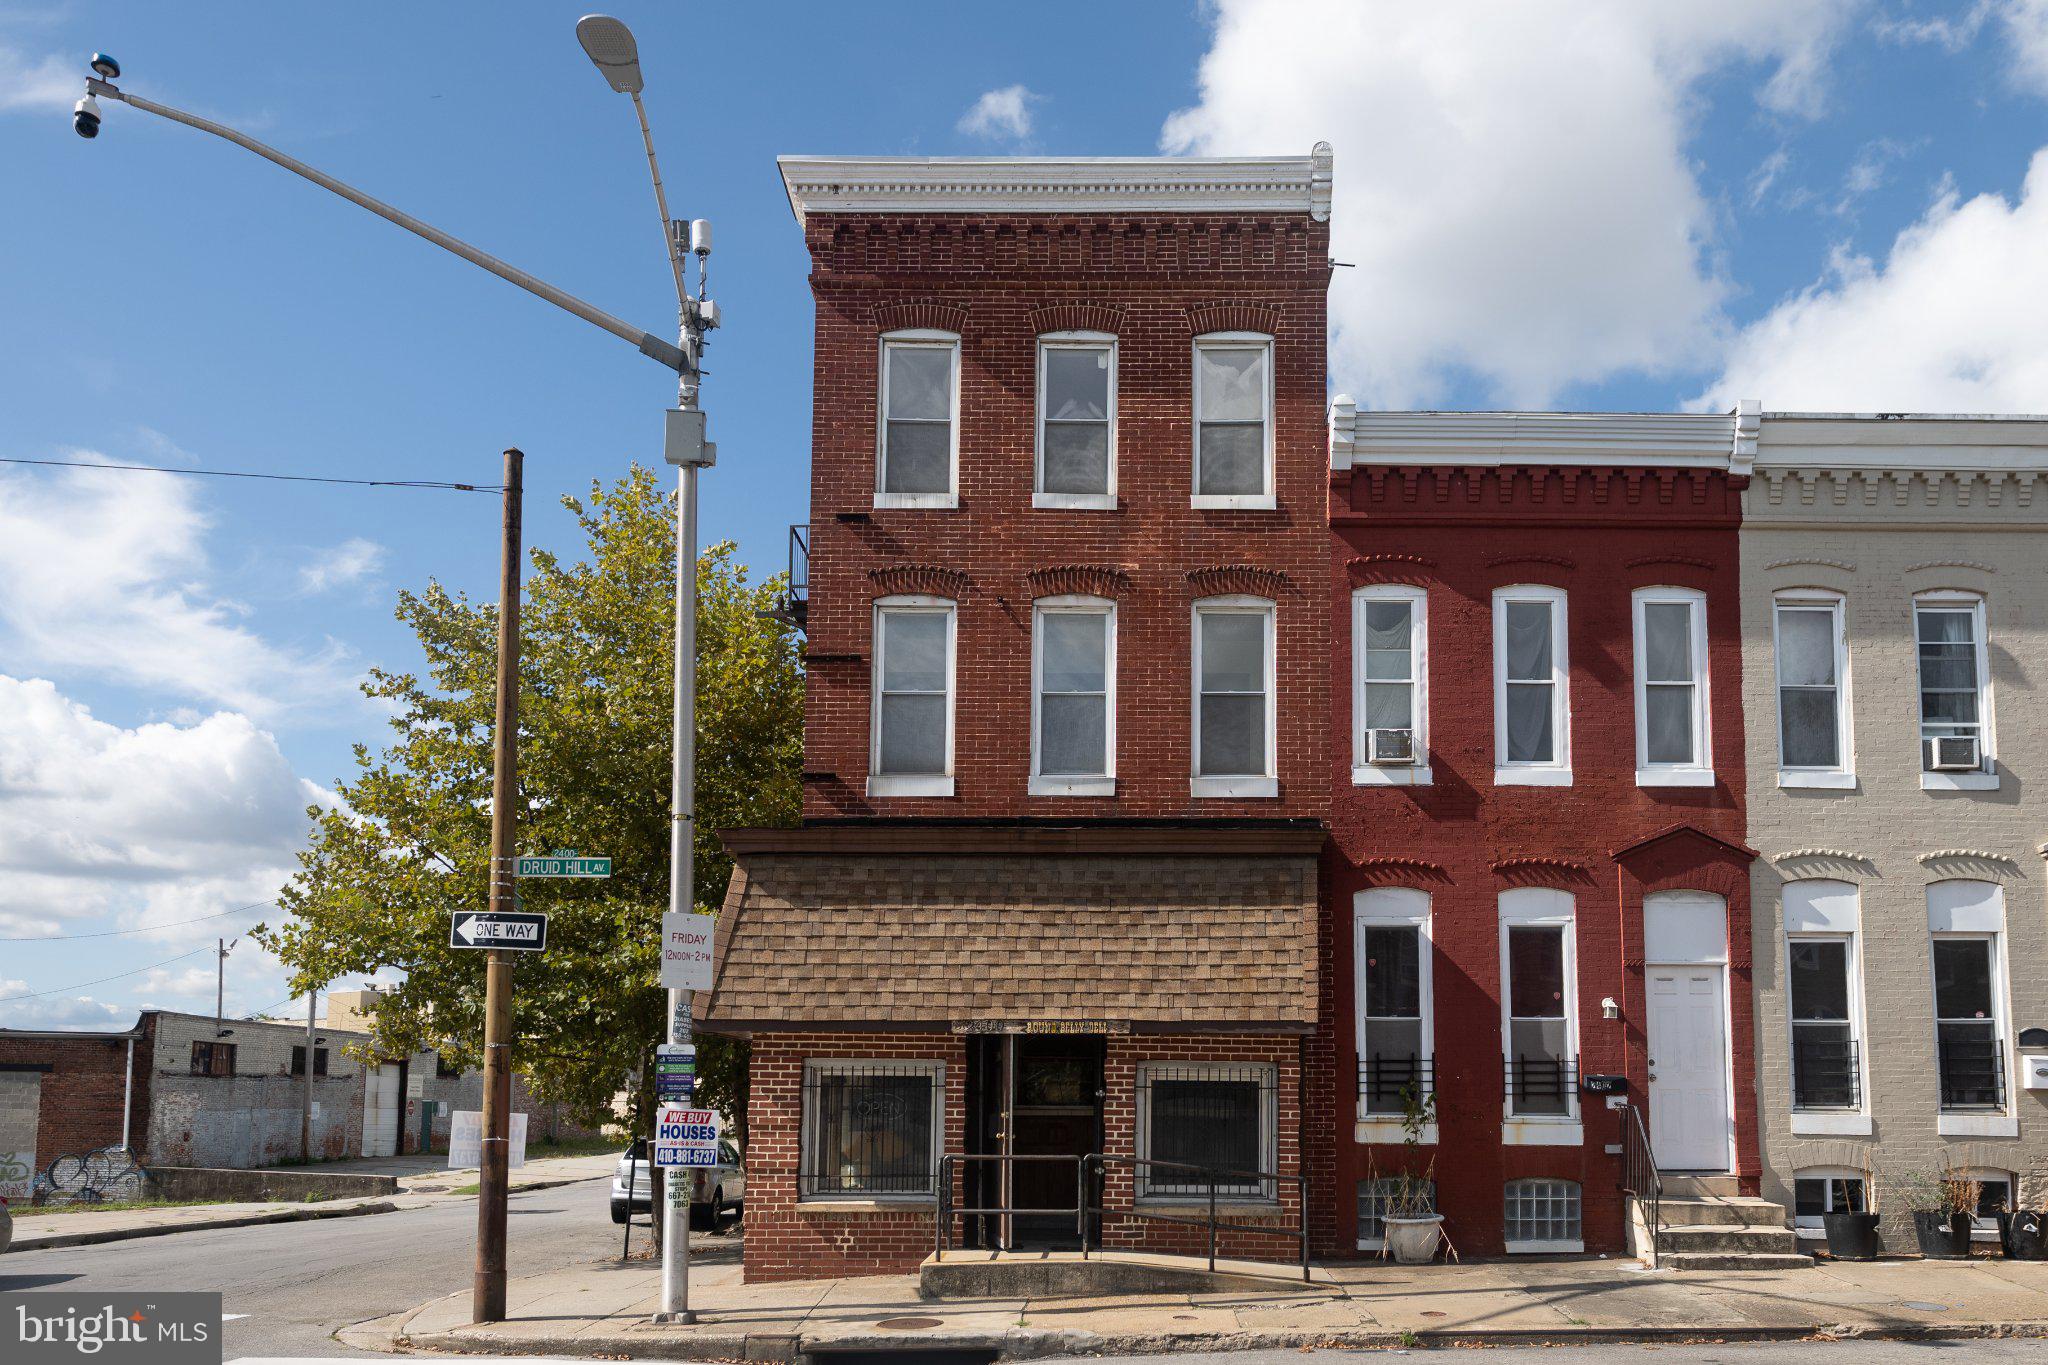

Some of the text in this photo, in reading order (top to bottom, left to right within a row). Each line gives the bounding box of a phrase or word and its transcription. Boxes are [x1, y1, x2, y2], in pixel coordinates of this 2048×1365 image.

[523, 861, 560, 874] DRUID
[565, 861, 592, 874] HILL
[476, 923, 533, 938] ONE WAY
[672, 932, 707, 946] FRIDAY
[675, 1002, 691, 1012] CAS
[1060, 1021, 1085, 1034] BELLY
[1089, 1021, 1108, 1034] DELI
[857, 1101, 900, 1115] OPEN
[669, 1111, 710, 1124] WE BUY
[660, 1124, 716, 1140] HOUSES
[658, 1148, 715, 1164] 410-881-6737
[669, 1170, 687, 1179] CASH
